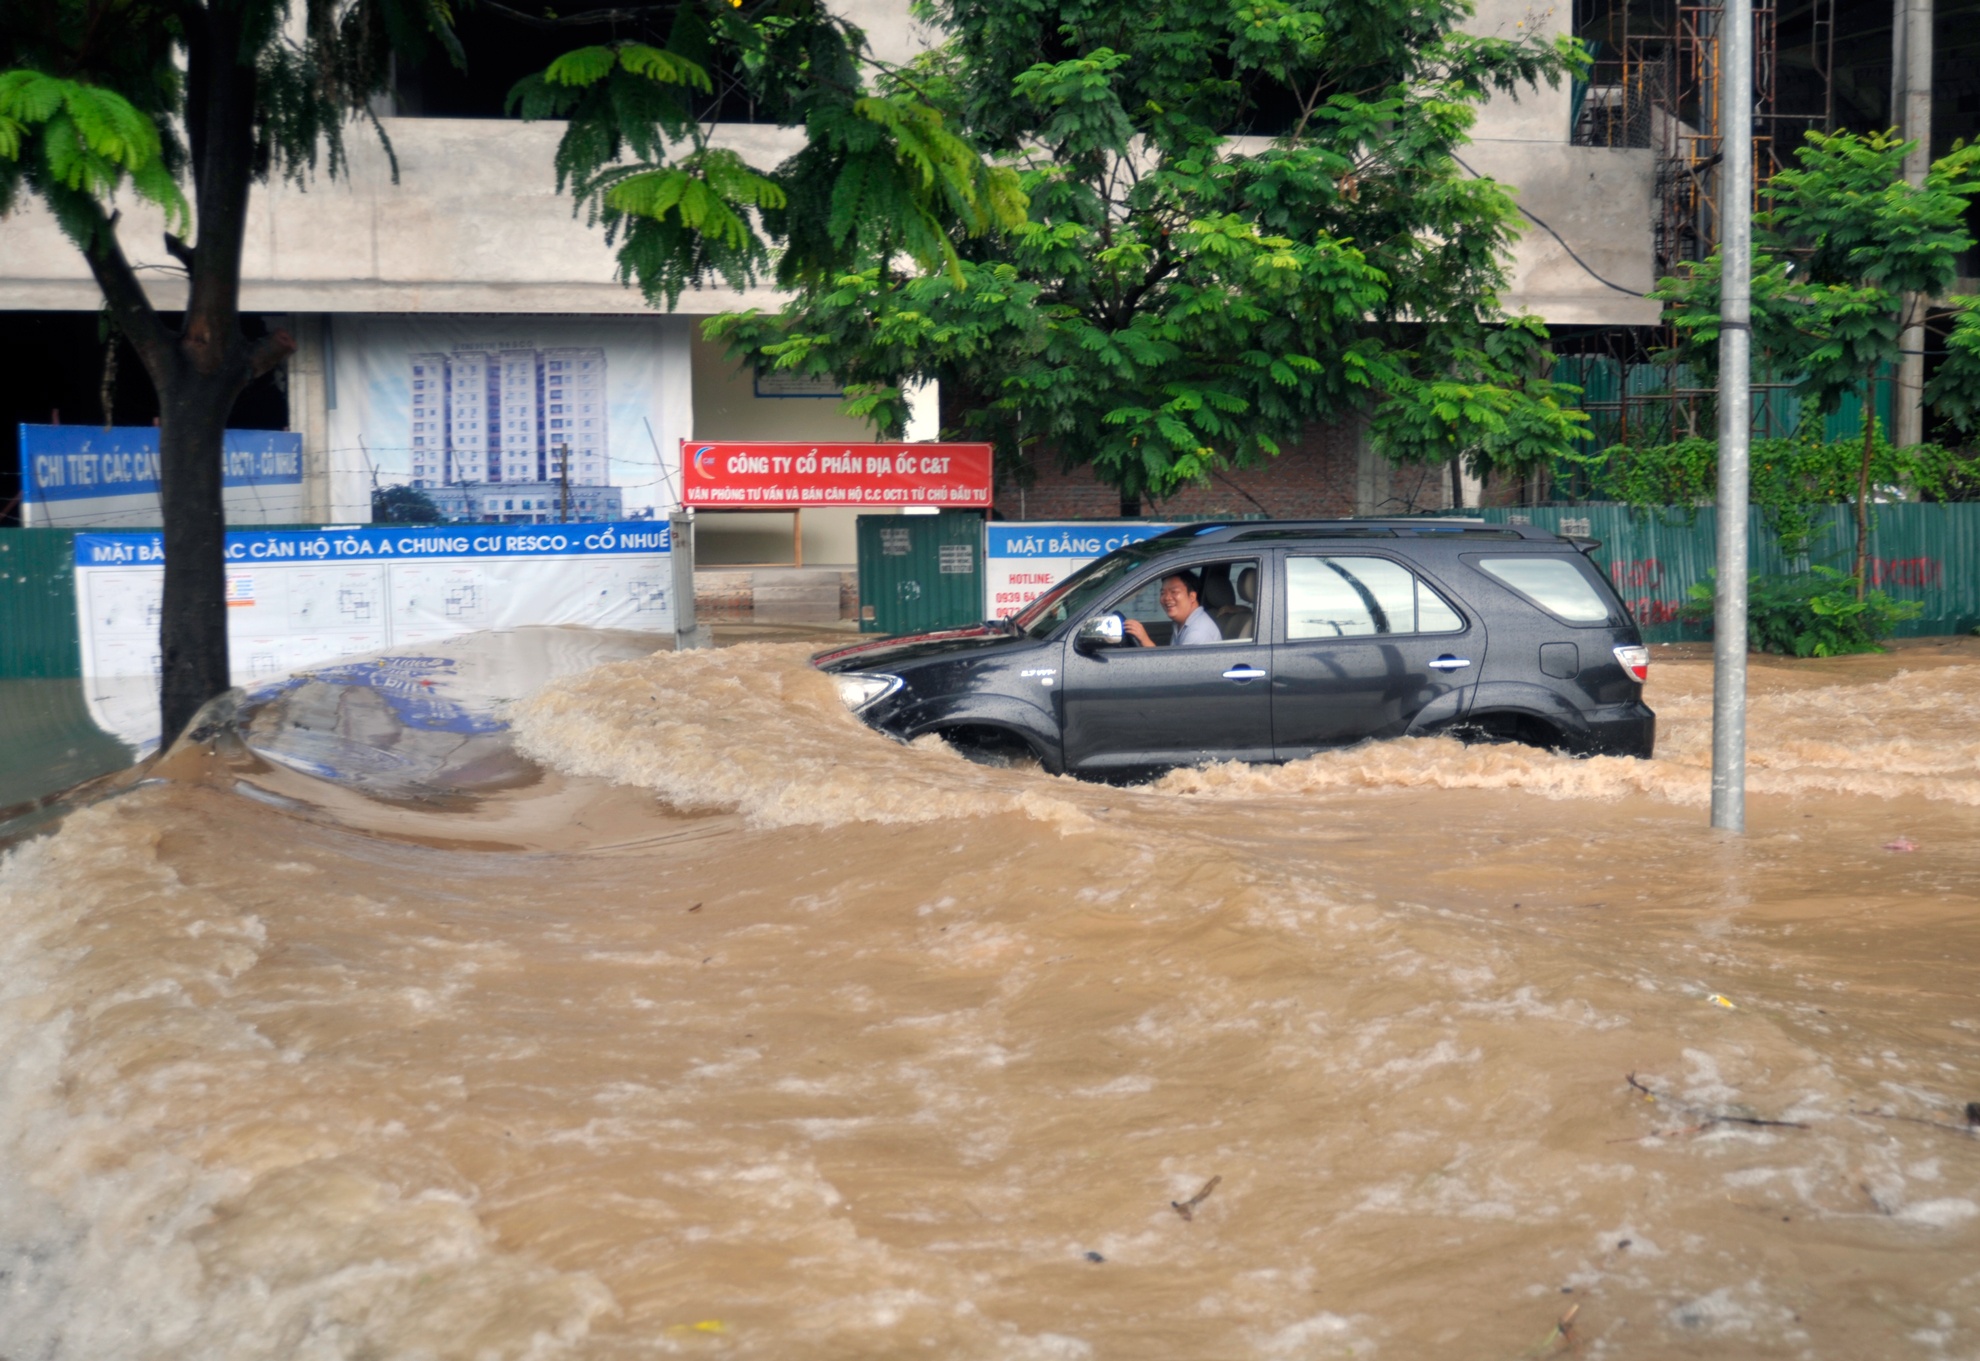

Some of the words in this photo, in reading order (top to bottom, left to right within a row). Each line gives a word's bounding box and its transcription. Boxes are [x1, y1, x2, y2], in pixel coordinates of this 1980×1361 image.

[37, 454, 65, 488] CHI
[67, 441, 99, 485] TIẾT
[102, 445, 132, 483] CÁC
[727, 452, 769, 474] CÔNG
[772, 456, 792, 474] TY
[795, 448, 818, 474] CỔ
[821, 450, 863, 474] PHẦN
[866, 456, 893, 477] ĐỊA
[896, 451, 918, 474] ỐC
[920, 456, 951, 474] C&T
[710, 485, 746, 501] PHÒNG
[747, 486, 762, 500] TƯ
[762, 484, 784, 500] VẤN
[801, 486, 823, 501] BÁN
[973, 487, 988, 500] TƯ
[93, 542, 135, 565] MẶT
[138, 538, 166, 562] BẰ
[250, 538, 295, 558] CĂN
[300, 537, 330, 559] HỘ
[333, 535, 374, 555] TÒA
[378, 539, 394, 554] A
[398, 536, 470, 555] CHUNG
[473, 535, 501, 552] CƯ
[506, 535, 568, 552] RESCO
[584, 526, 616, 550] CỔ
[620, 527, 670, 549] NHUẾ
[1006, 535, 1045, 557] MẶT
[1049, 532, 1101, 553] BẰNG
[1009, 573, 1054, 585] HOTLINE:
